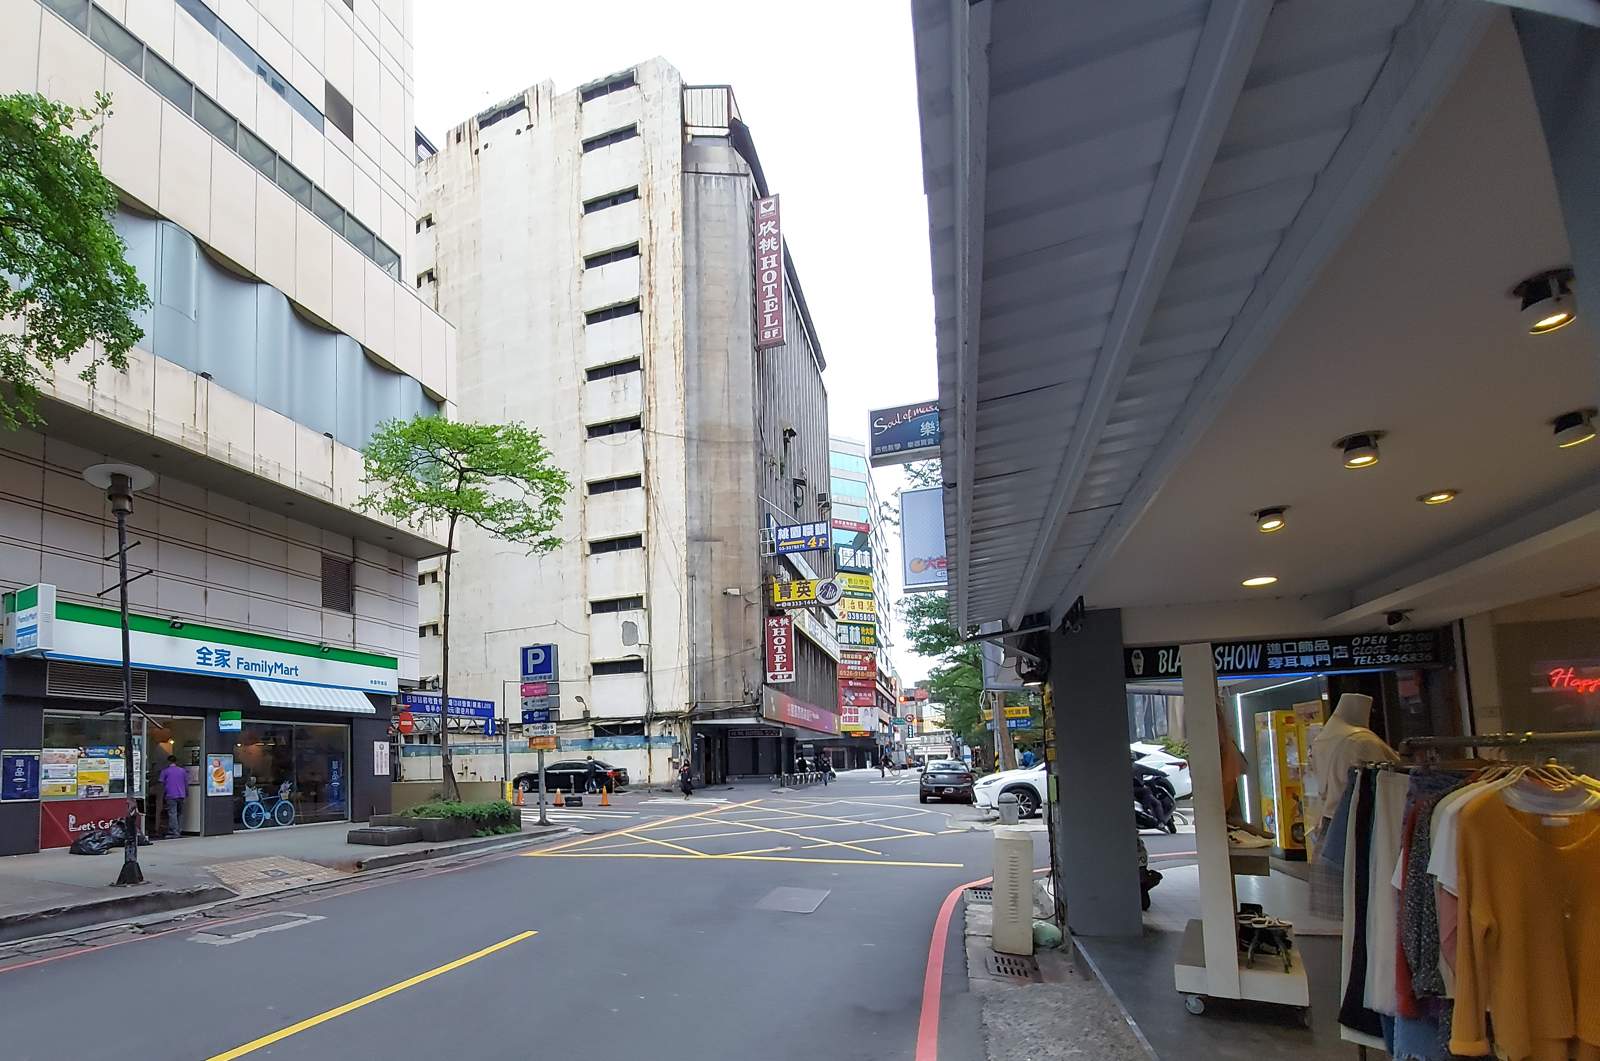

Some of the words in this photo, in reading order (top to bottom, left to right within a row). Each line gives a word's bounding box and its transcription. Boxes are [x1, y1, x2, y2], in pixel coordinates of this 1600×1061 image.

[760, 253, 779, 328] HOTEL
[873, 412, 903, 436] Soul
[903, 408, 912, 422] of
[778, 580, 811, 599] 菁英
[771, 627, 787, 672] HOTEL
[1332, 645, 1349, 659] 店
[1351, 635, 1388, 646] OPEN
[1351, 645, 1389, 656] CLOSE
[195, 646, 231, 668] 全家
[236, 657, 299, 677] FamilyMart
[527, 648, 545, 673] P
[1214, 643, 1263, 671] SHOW
